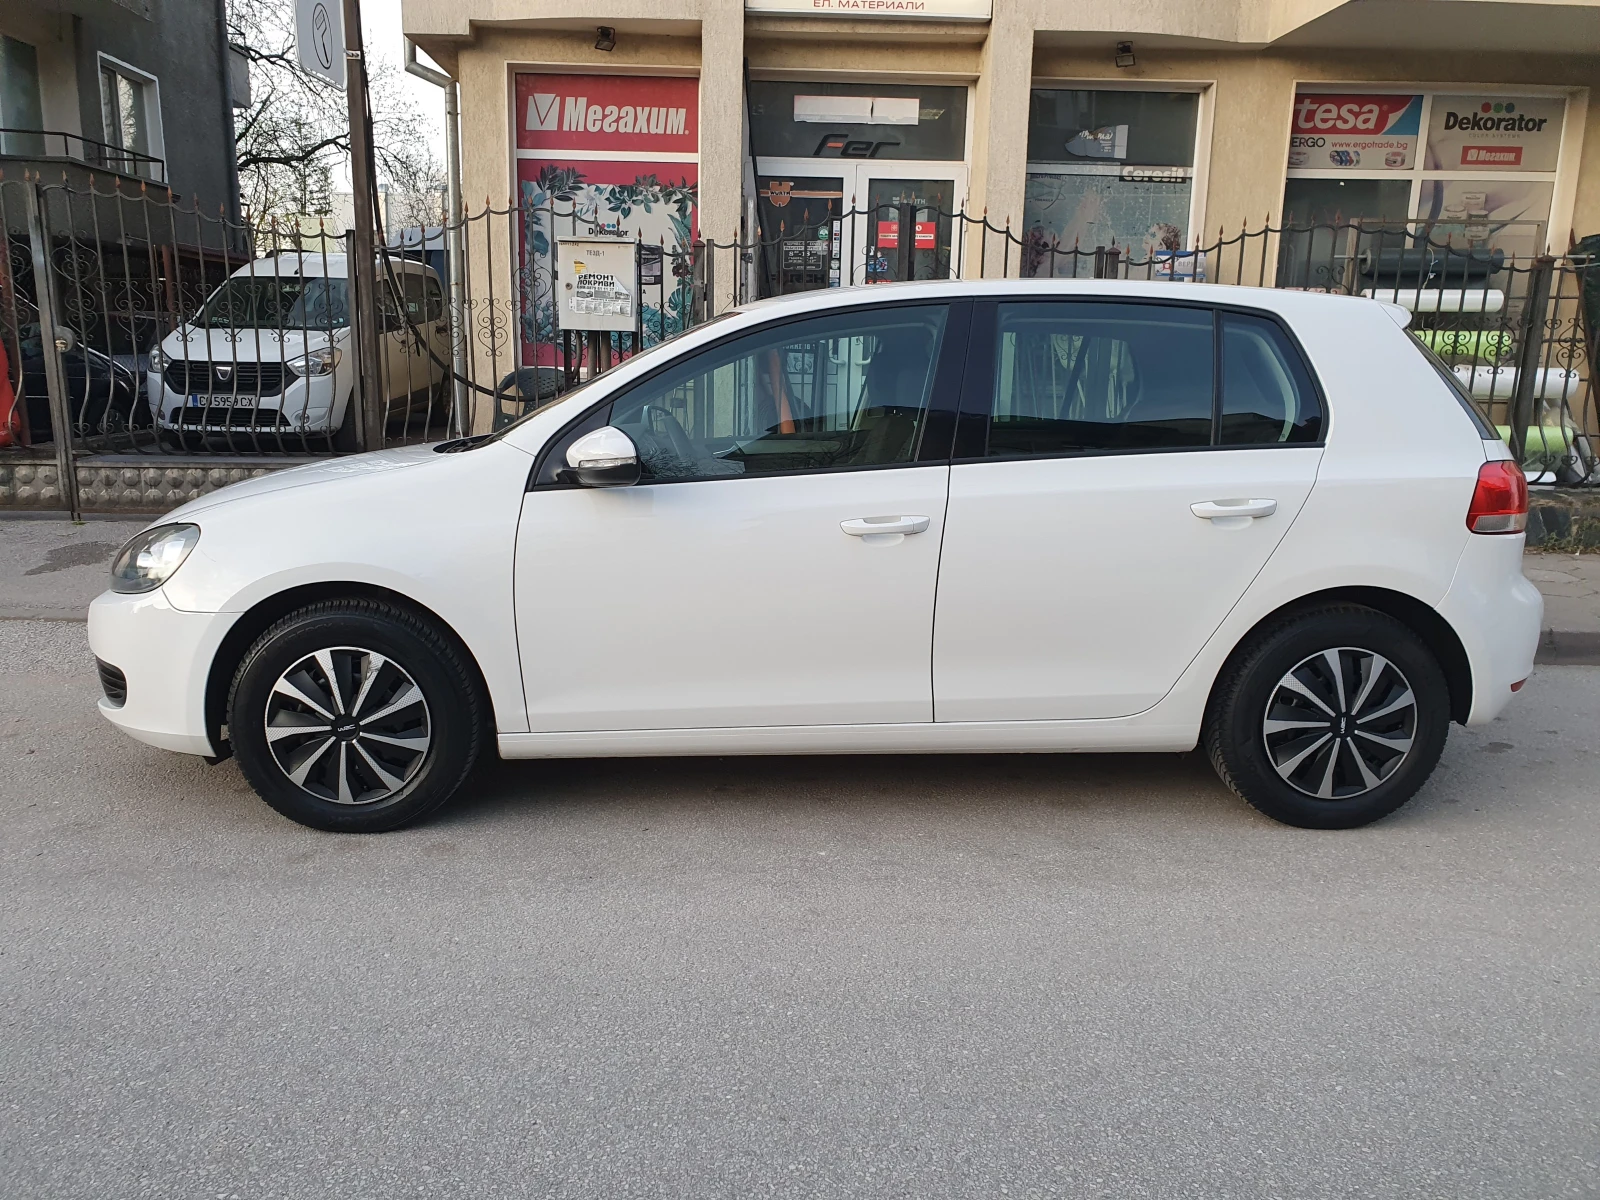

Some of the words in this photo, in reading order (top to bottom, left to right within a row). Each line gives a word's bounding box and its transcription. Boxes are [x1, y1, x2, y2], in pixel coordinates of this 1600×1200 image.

[813, 0, 833, 8] ЕЛ.
[838, 0, 925, 11] МАТЕРИАЛИ
[1295, 98, 1380, 130] tesa
[1444, 111, 1548, 132] Dekorator
[1291, 137, 1326, 148] ERGO
[1331, 141, 1408, 150] www.ergotrade.bg
[1122, 166, 1185, 182] Ceresit
[588, 227, 629, 237] Dkoraor
